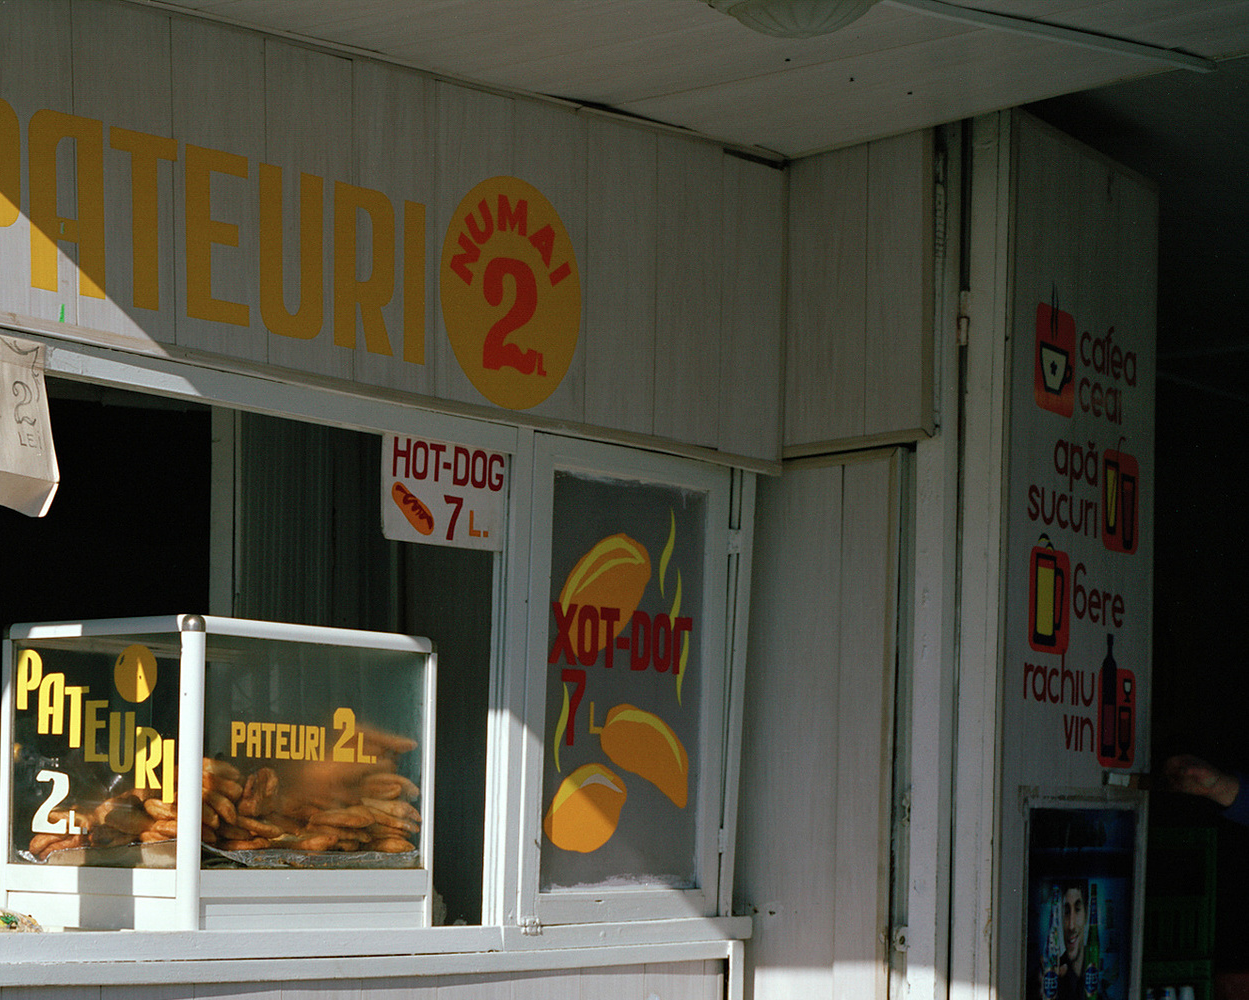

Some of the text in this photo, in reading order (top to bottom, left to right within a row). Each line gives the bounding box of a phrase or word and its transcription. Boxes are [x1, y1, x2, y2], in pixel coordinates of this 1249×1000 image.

[450, 194, 572, 287] NUMAI
[1080, 326, 1137, 387] cafea
[12, 380, 37, 426] 2
[1079, 377, 1123, 425] ceai
[392, 436, 505, 491] HOT-DOG
[1054, 439, 1098, 491] apă
[443, 494, 463, 541] 7
[1027, 485, 1098, 538] sucuri
[1023, 649, 1095, 707] rachiu
[16, 649, 175, 804] PATEURI
[561, 669, 587, 746] 7
[1063, 714, 1094, 752] vin
[231, 721, 326, 762] PATEURI
